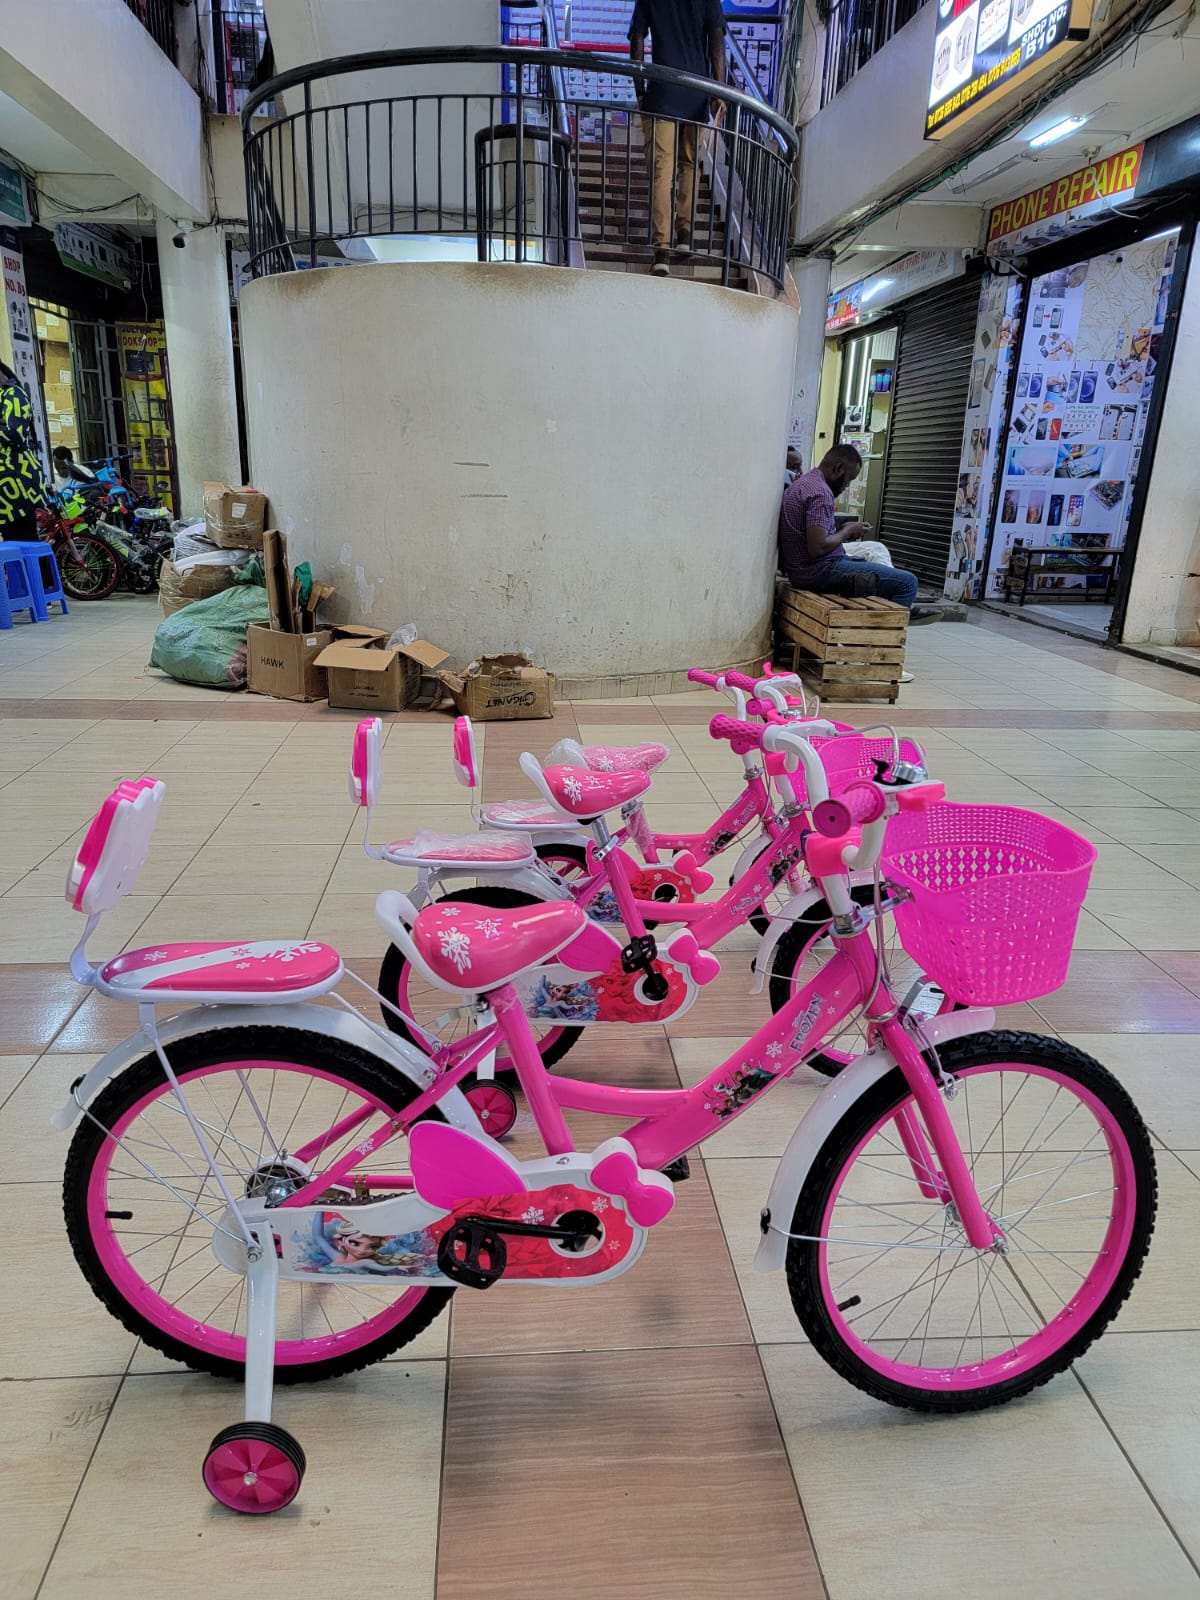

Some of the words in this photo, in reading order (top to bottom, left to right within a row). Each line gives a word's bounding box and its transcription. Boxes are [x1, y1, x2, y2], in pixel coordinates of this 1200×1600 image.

[1021, 20, 1047, 47] SHOP
[1025, 24, 1057, 60] B10
[989, 185, 1052, 241] PHONE
[1053, 150, 1138, 214] REPAIR
[4, 256, 21, 273] SHOP
[260, 656, 285, 670] HAWK
[790, 993, 826, 1053] FROZEN
